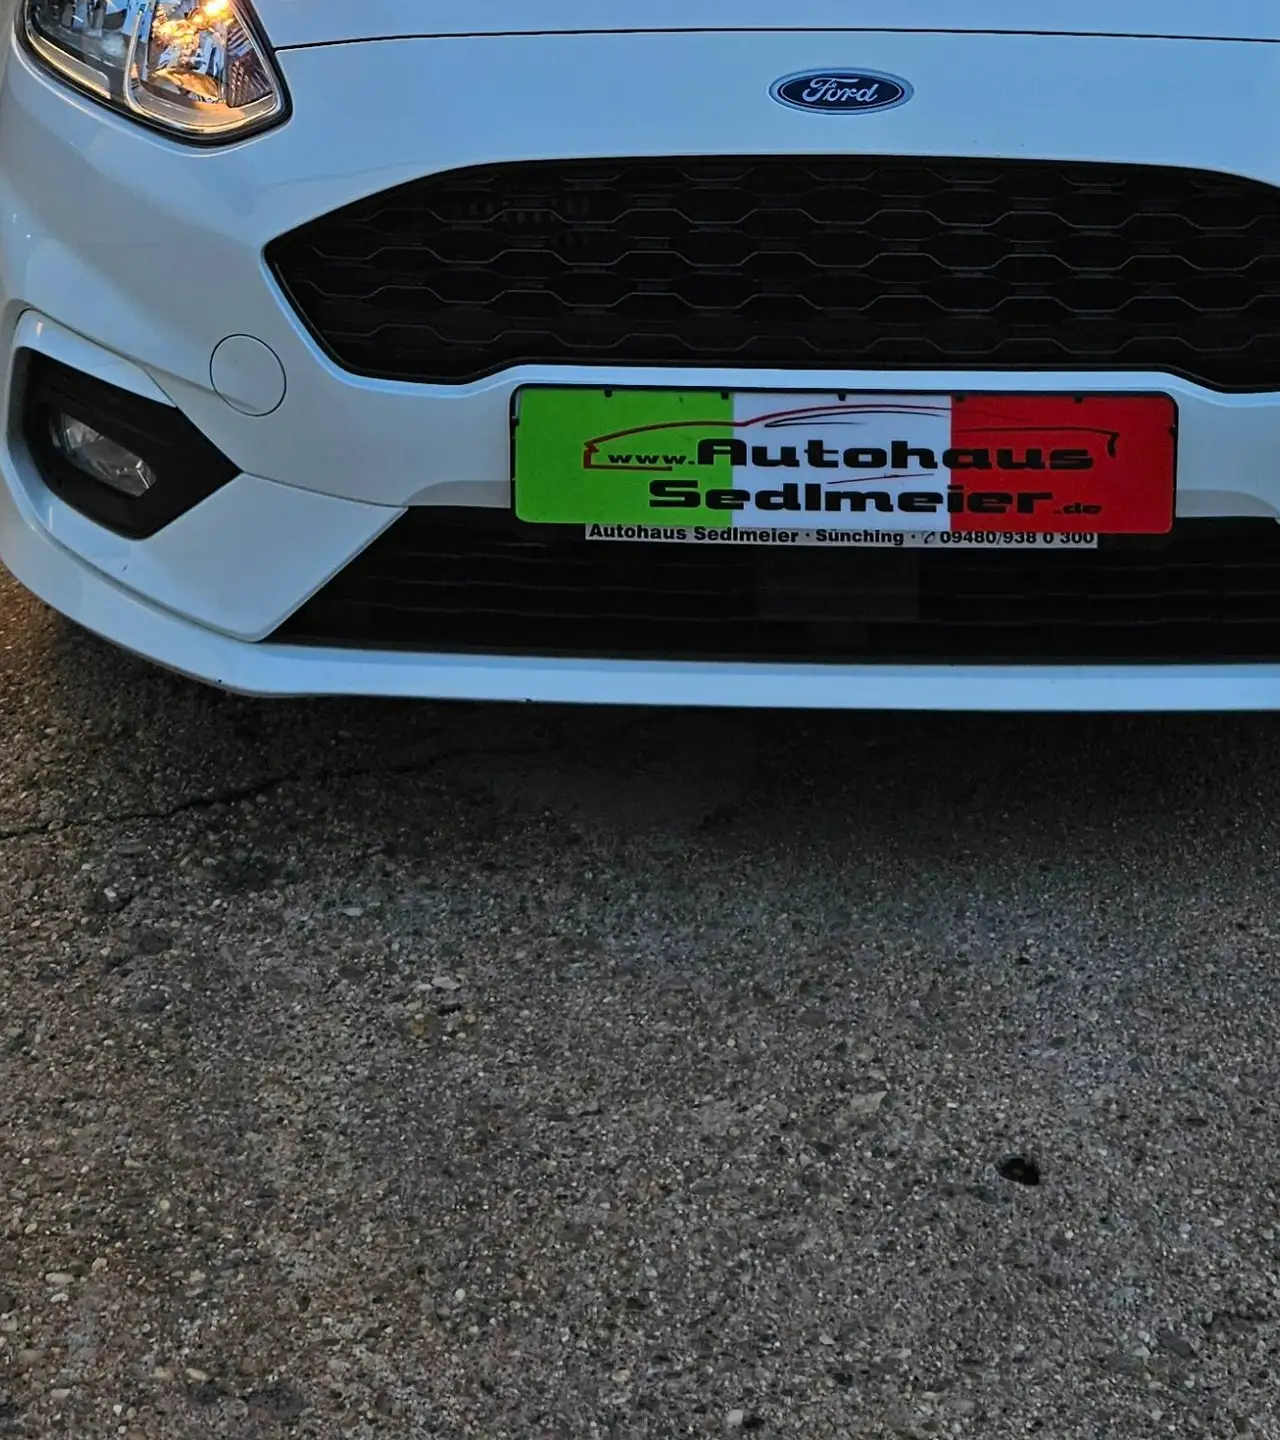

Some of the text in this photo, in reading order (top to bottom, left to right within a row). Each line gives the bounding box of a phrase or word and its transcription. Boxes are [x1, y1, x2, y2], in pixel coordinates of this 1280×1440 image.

[801, 76, 879, 103] Ford
[589, 523, 687, 541] Autohaus
[693, 525, 799, 544] Sedlmeier
[816, 527, 905, 546] Sünching
